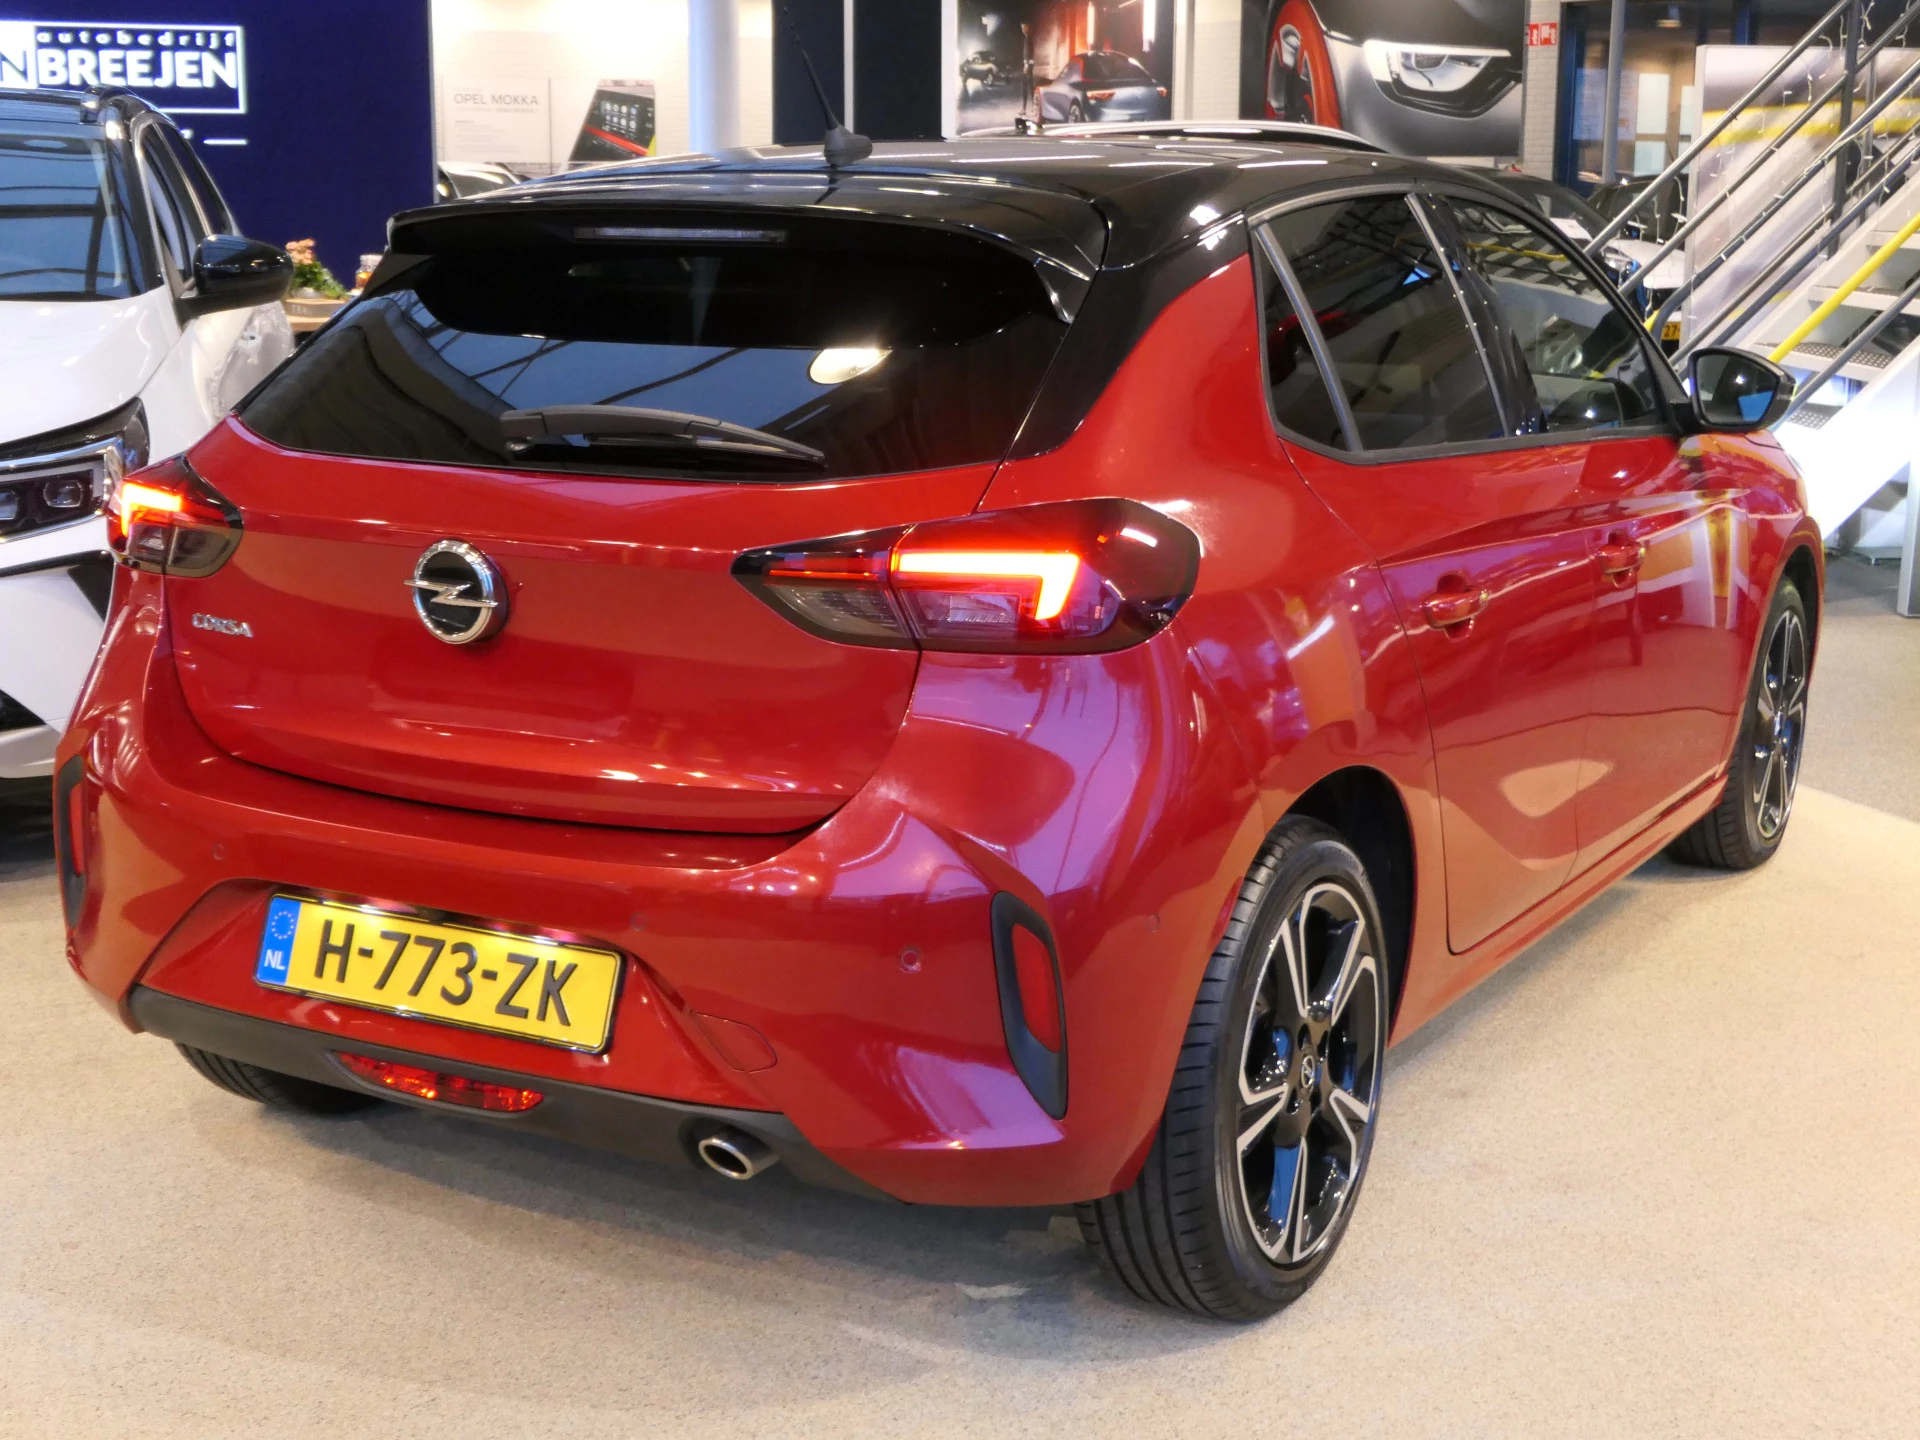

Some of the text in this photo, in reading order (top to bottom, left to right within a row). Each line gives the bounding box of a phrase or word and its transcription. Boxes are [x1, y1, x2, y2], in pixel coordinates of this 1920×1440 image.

[36, 30, 235, 49] autobedrijf
[37, 48, 237, 88] BREEJEN
[454, 93, 539, 106] OPEL MOKKA
[191, 612, 254, 638] CORSA
[263, 950, 285, 971] NL
[314, 919, 578, 1027] H-773-ZK
